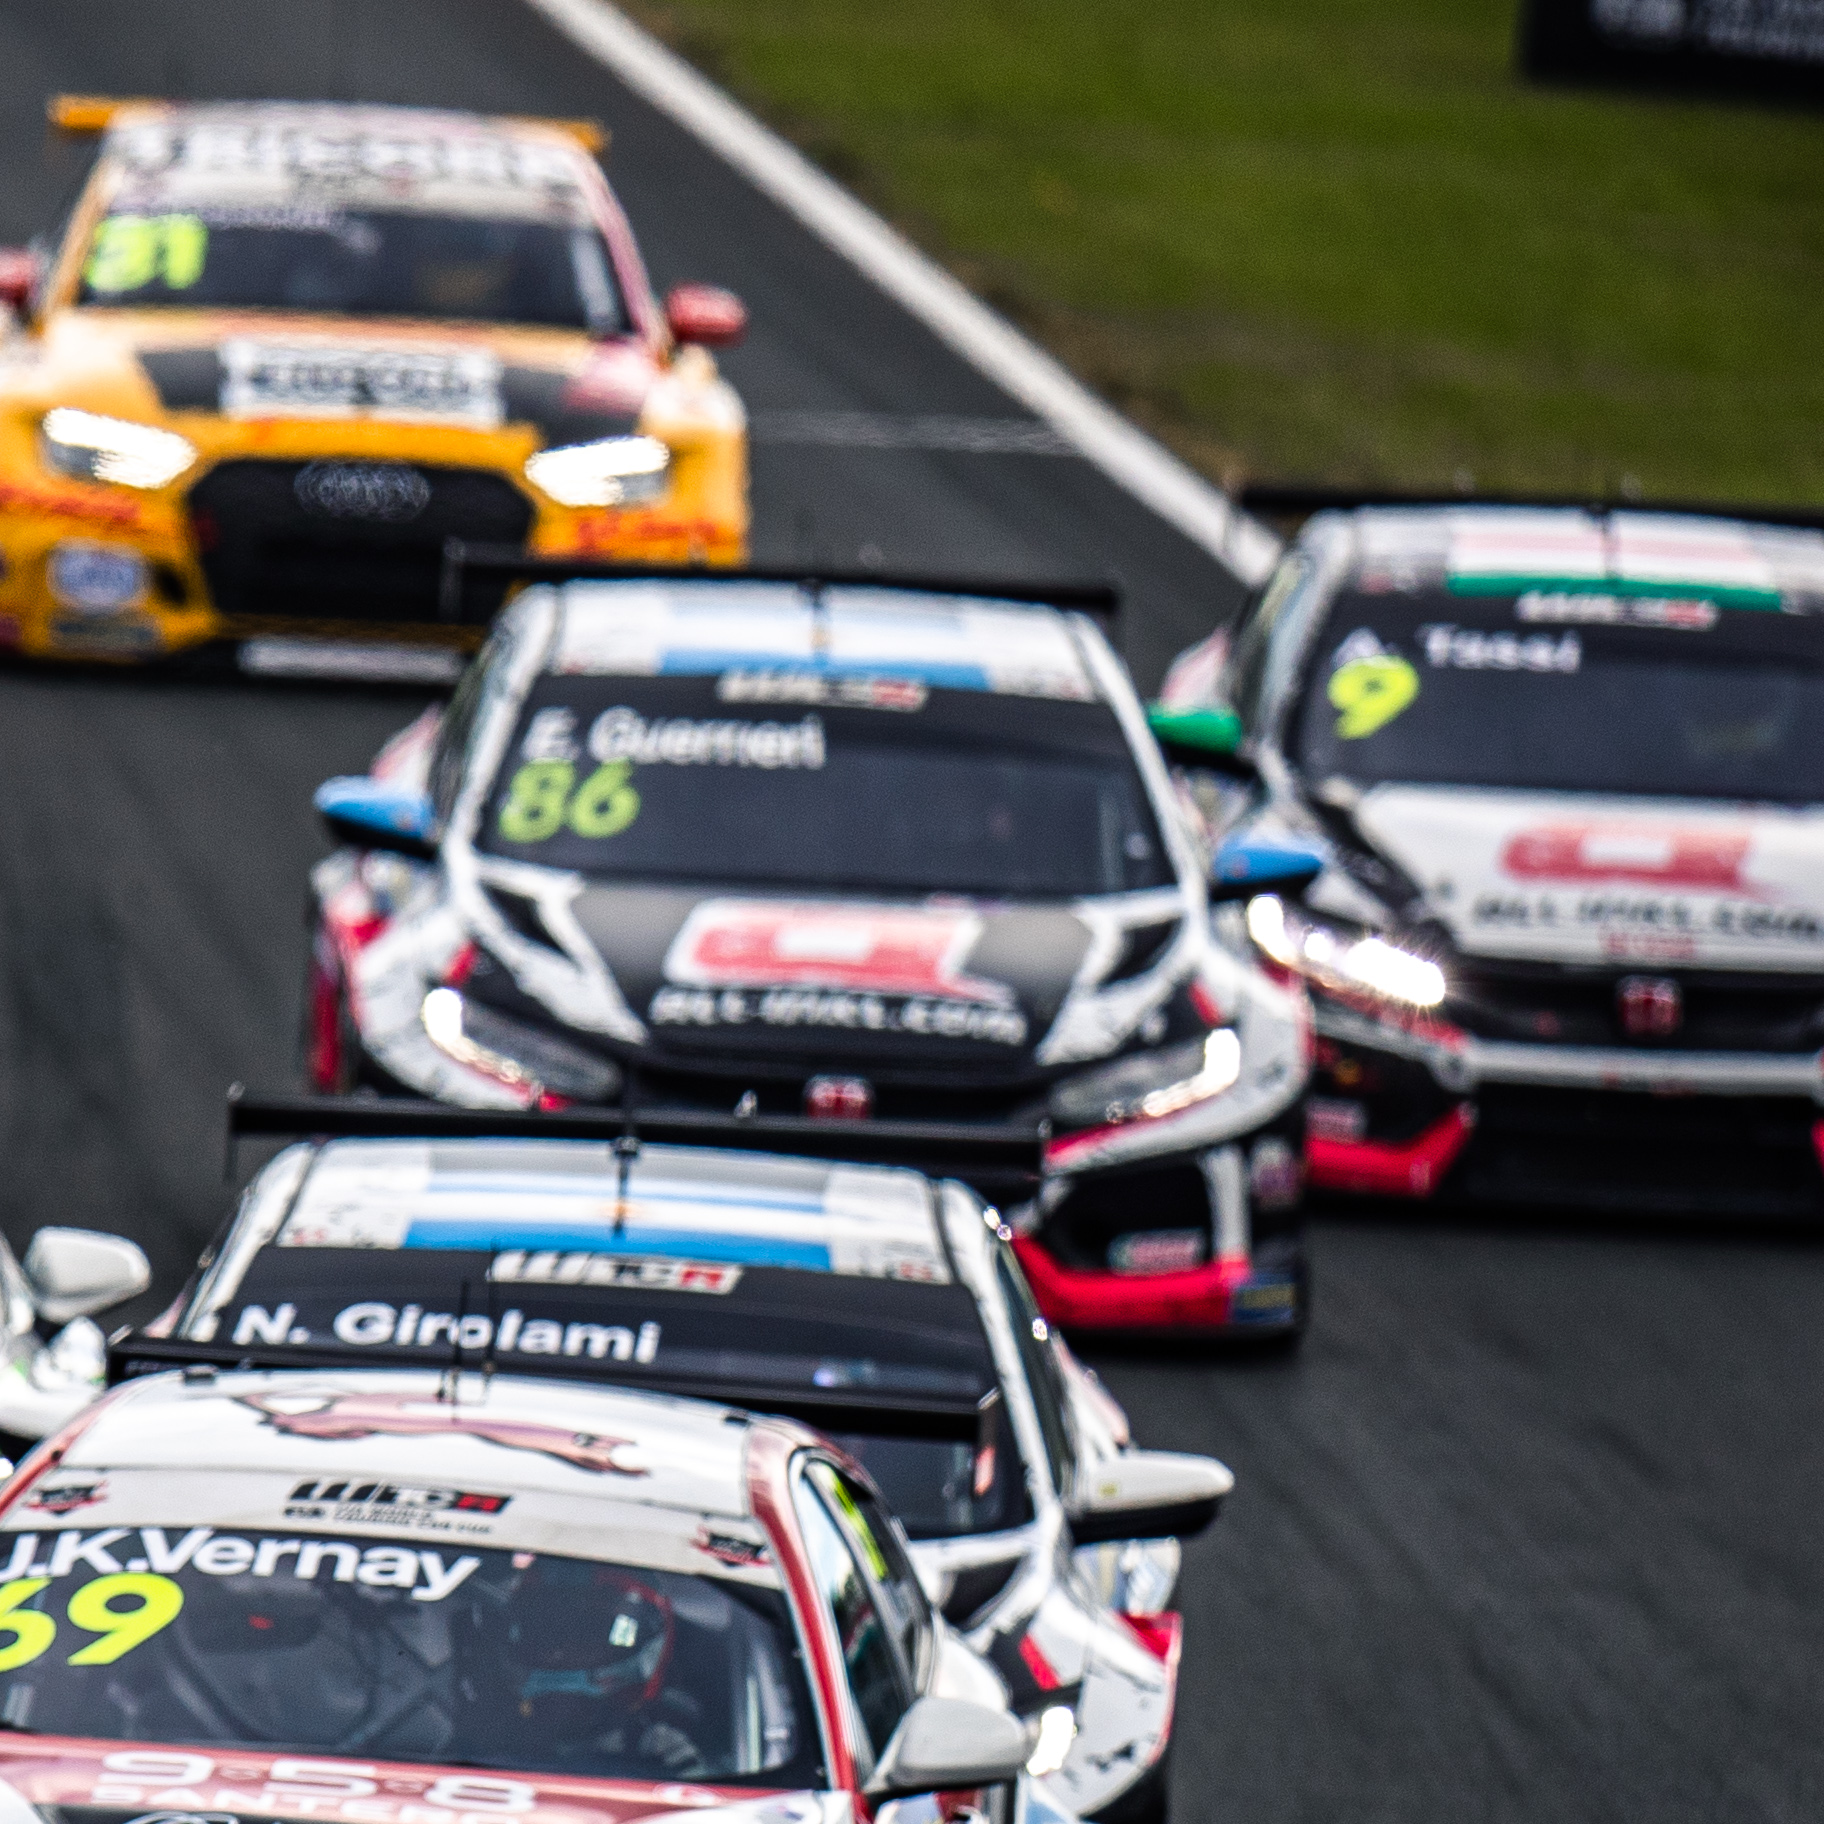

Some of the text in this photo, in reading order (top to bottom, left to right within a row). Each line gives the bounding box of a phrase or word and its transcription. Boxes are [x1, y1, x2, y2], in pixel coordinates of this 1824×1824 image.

[1328, 654, 1420, 739] 9
[498, 756, 642, 844] 86
[231, 1302, 663, 1365] N. Girolami
